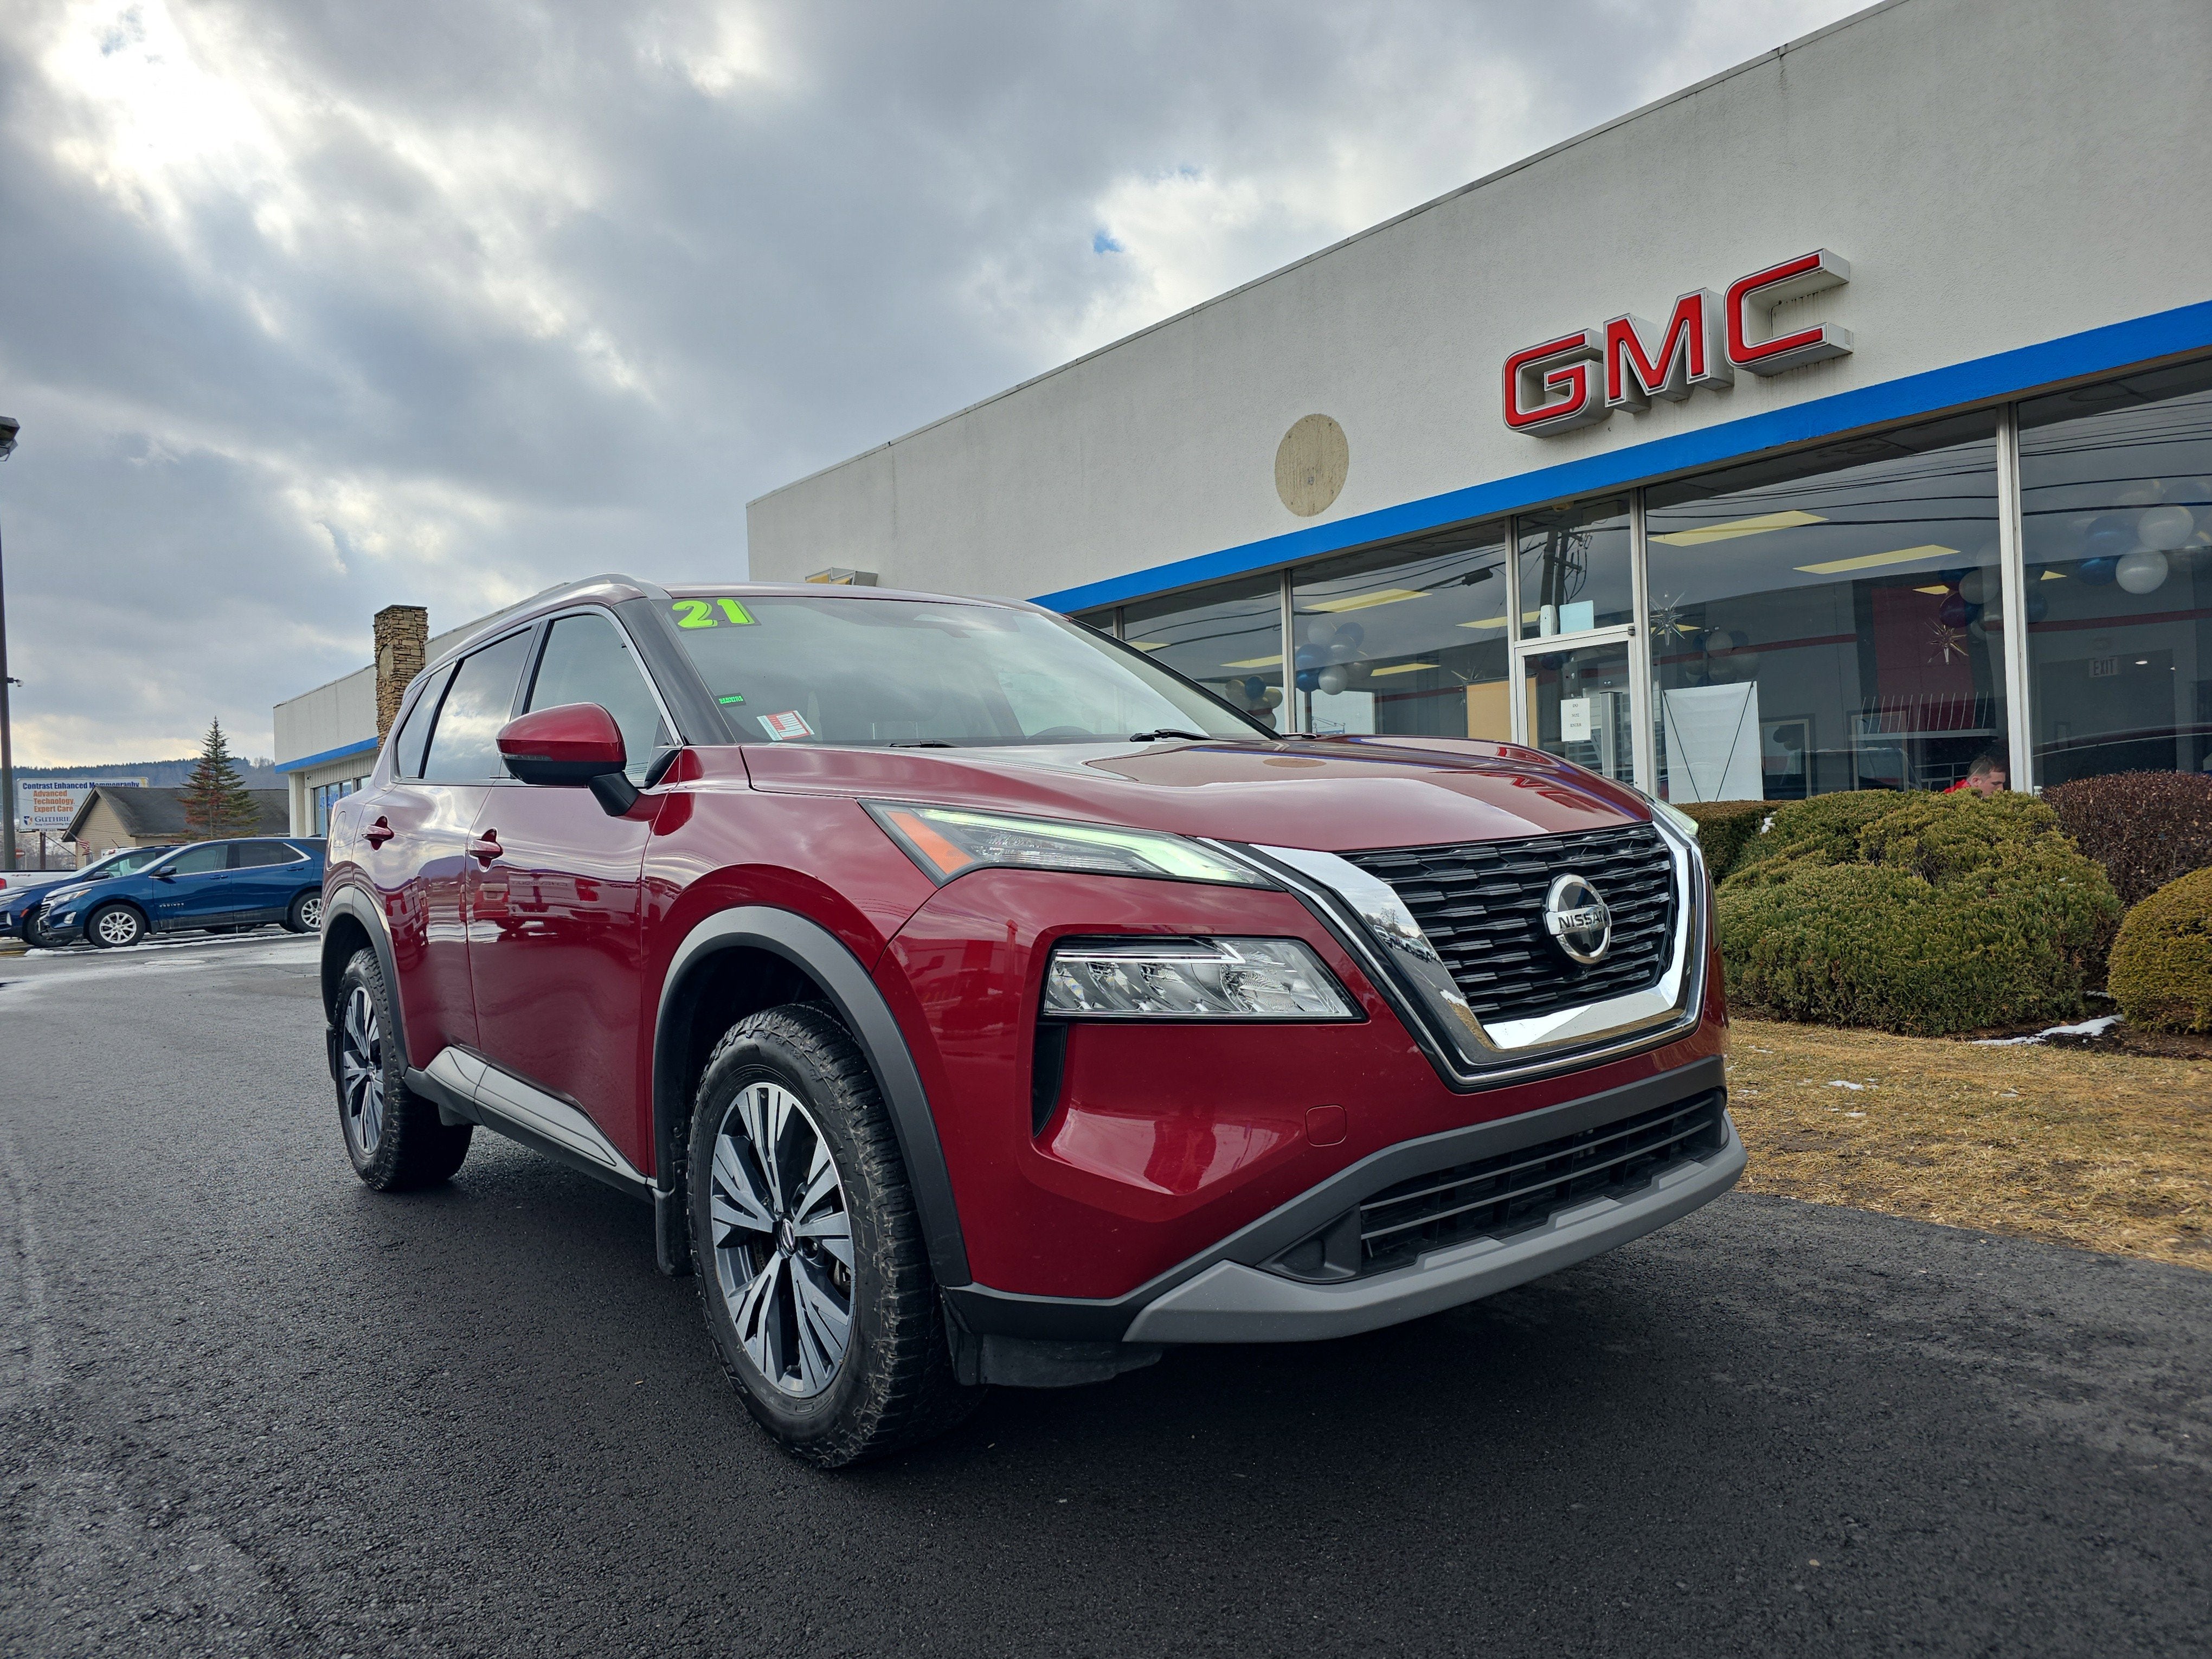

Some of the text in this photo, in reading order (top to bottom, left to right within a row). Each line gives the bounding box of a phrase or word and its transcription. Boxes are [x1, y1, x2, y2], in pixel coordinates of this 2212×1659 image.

[1501, 248, 1837, 435] GMC
[672, 599, 754, 628] 21
[2094, 658, 2115, 676] EXIT
[1558, 910, 1607, 929] NISSAN
